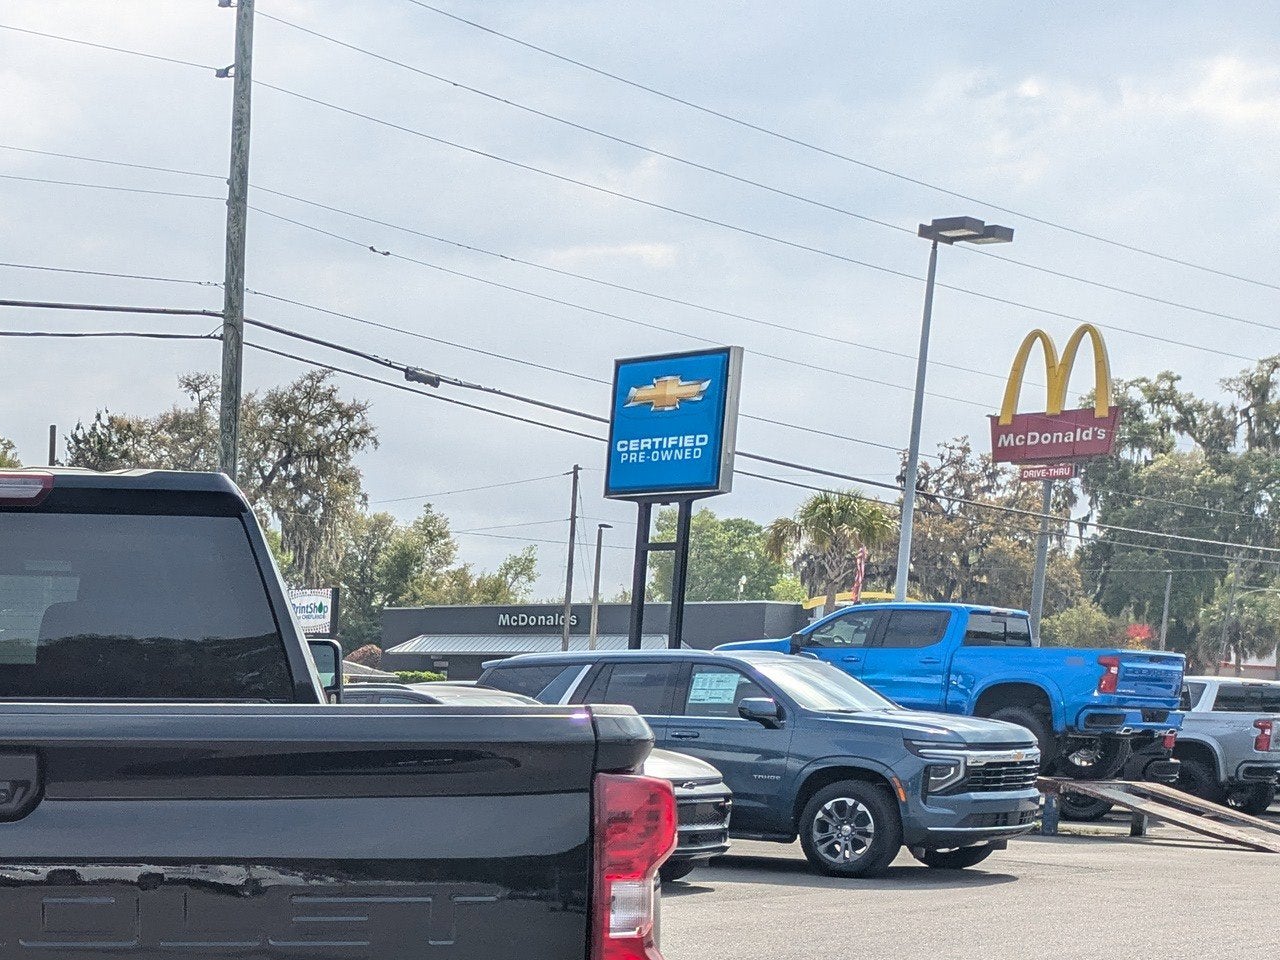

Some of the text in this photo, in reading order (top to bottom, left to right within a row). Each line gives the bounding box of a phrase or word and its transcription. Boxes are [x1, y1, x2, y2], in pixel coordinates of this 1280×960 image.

[616, 434, 709, 452] CERTIFIED
[997, 426, 1107, 448] McDonald's
[620, 447, 702, 464] PRE-OWNED
[1022, 467, 1071, 479] DRIVE-THRU
[498, 613, 577, 626] McDonals
